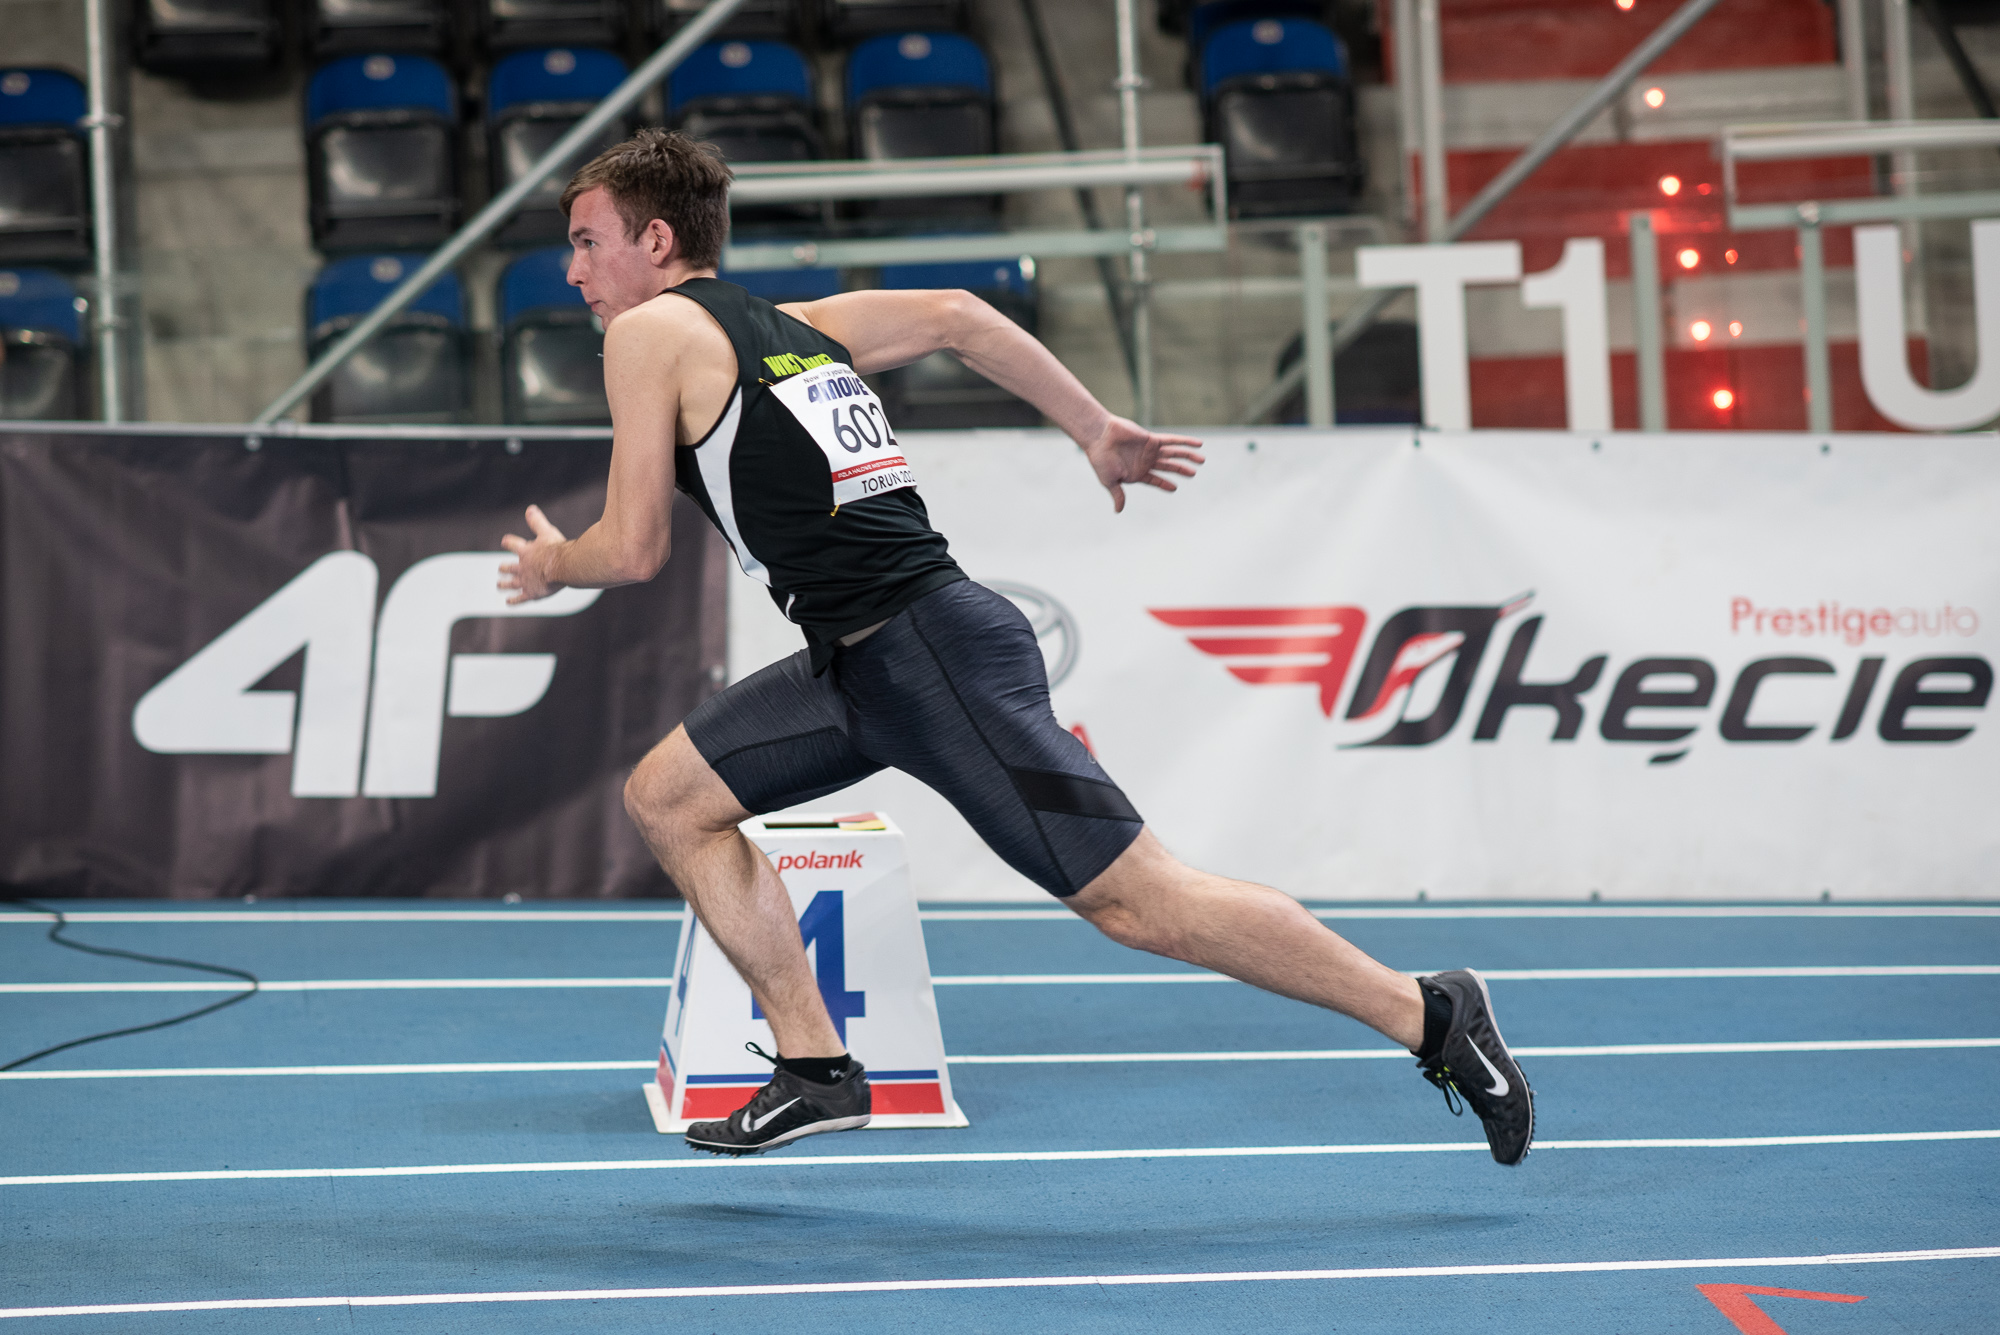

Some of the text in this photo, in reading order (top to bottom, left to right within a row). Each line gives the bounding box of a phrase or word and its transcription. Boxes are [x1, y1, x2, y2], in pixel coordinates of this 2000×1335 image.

[1356, 236, 1613, 431] T1
[1853, 218, 2000, 431] U
[763, 352, 802, 377] WKS
[803, 375, 819, 384] Now
[832, 402, 898, 453] 602
[1730, 596, 1979, 647] Prestigeauto
[133, 550, 604, 798] 4F
[777, 849, 864, 874] polanik
